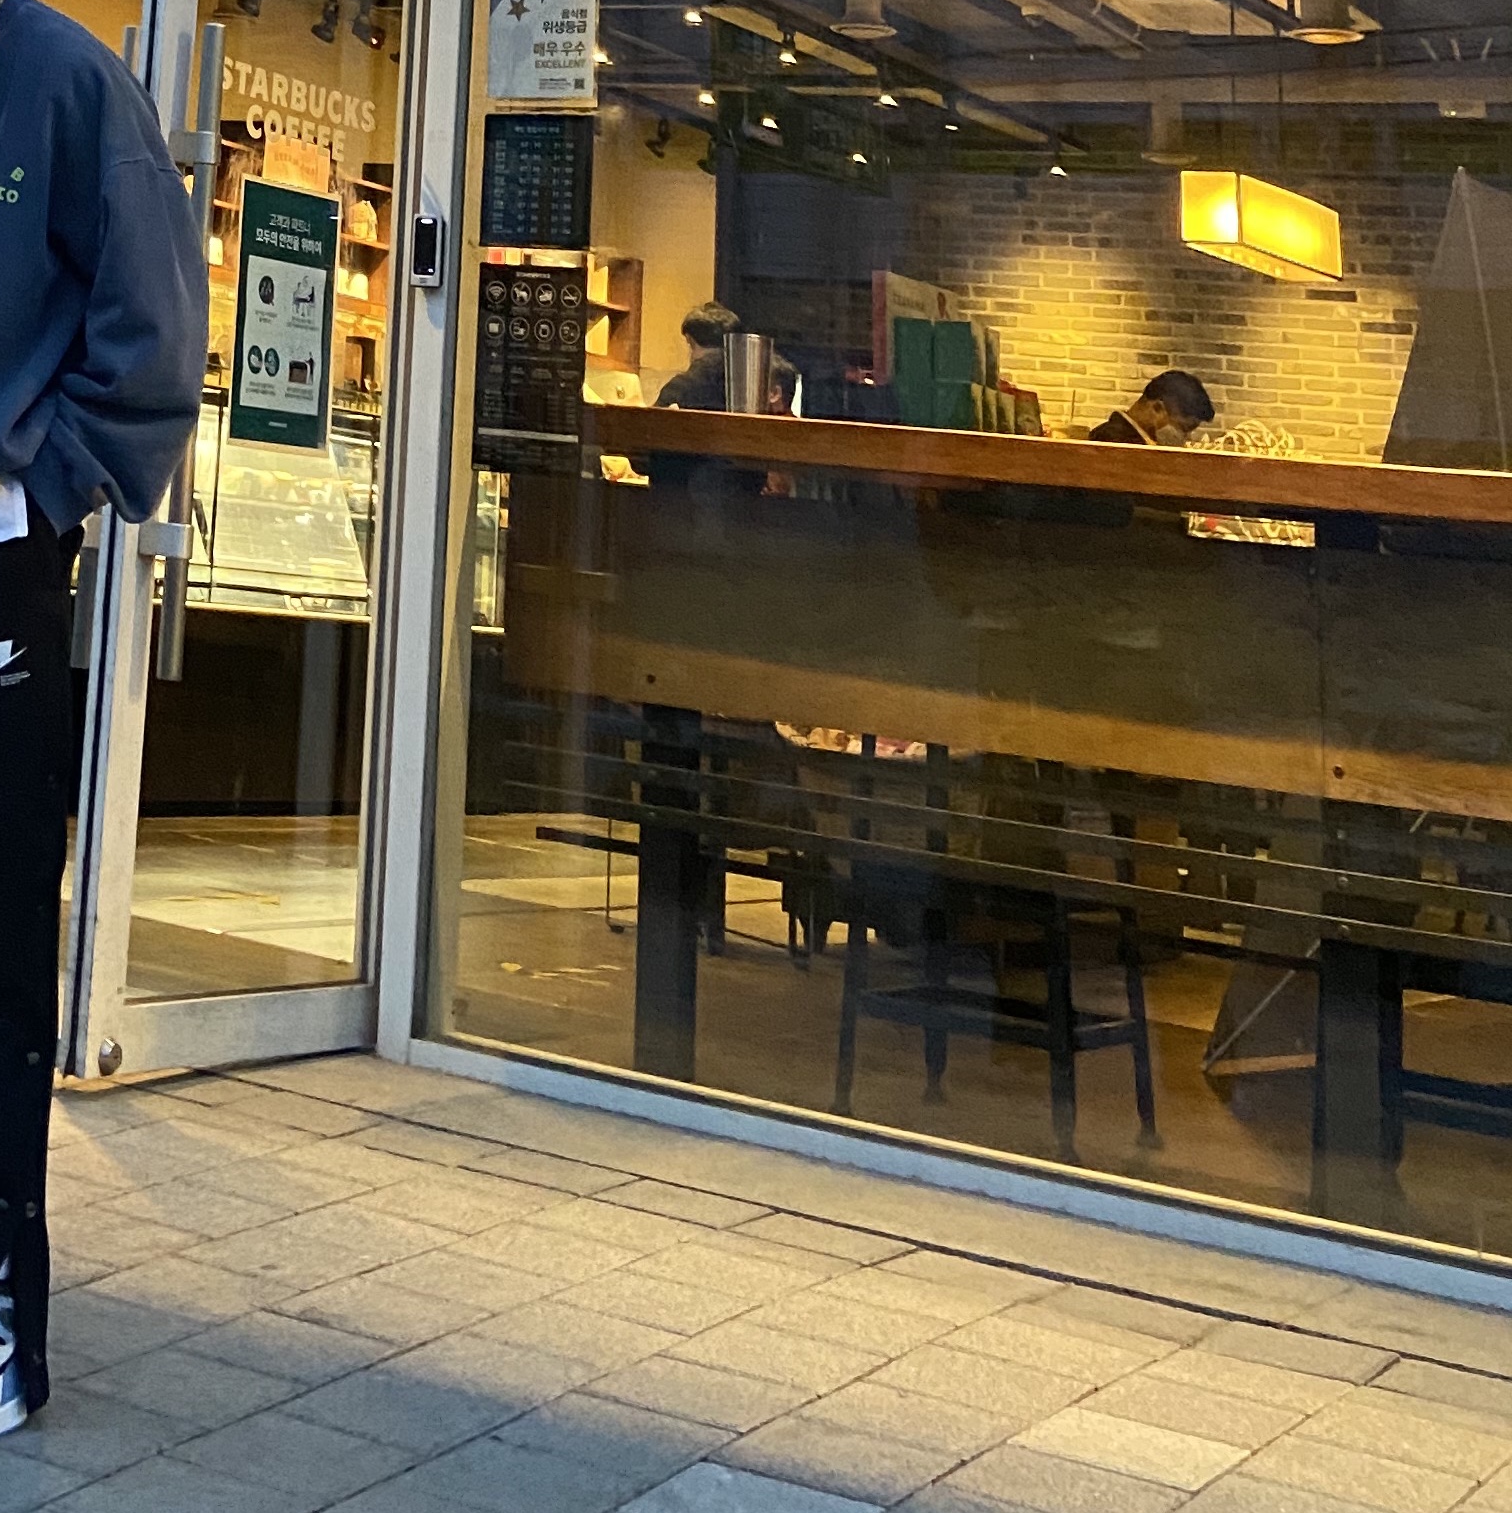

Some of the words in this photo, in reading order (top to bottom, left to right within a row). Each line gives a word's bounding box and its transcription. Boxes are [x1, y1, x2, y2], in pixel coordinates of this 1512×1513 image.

[542, 20, 587, 35] 위생등급
[533, 41, 558, 57] 매우
[561, 41, 586, 57] 우수
[535, 59, 587, 70] EXCELLENT
[223, 56, 377, 133] STARBUCKS
[246, 104, 348, 163] COFFEE
[255, 228, 278, 247] 모두의
[279, 233, 300, 252] 안전을
